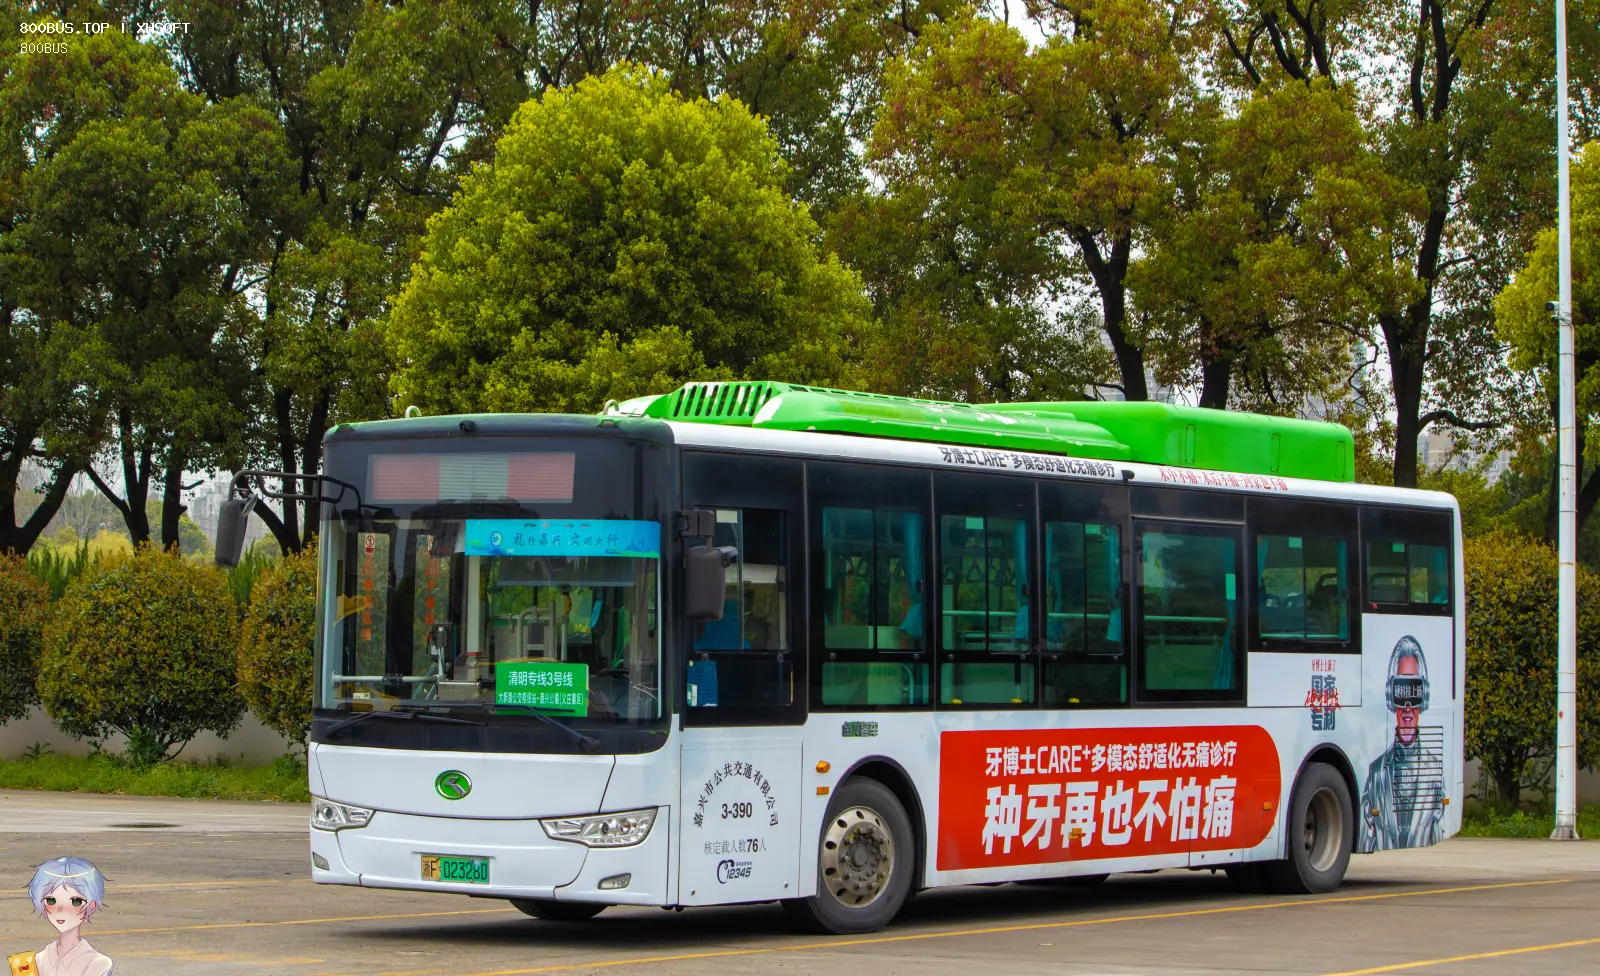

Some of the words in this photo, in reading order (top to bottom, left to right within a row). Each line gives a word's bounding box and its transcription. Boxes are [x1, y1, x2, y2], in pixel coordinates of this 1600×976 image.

[508, 671, 574, 687] 清明专线3号线
[1394, 684, 1423, 699] 硬科技上新
[841, 720, 879, 738] 金龙客车
[693, 760, 779, 830] 嘉兴市公共交通有限公司
[721, 802, 753, 819] 3-390
[981, 774, 1238, 856] 种牙再也不怕痛
[704, 837, 767, 856] 核定载人数76人
[726, 866, 752, 880] 12345
